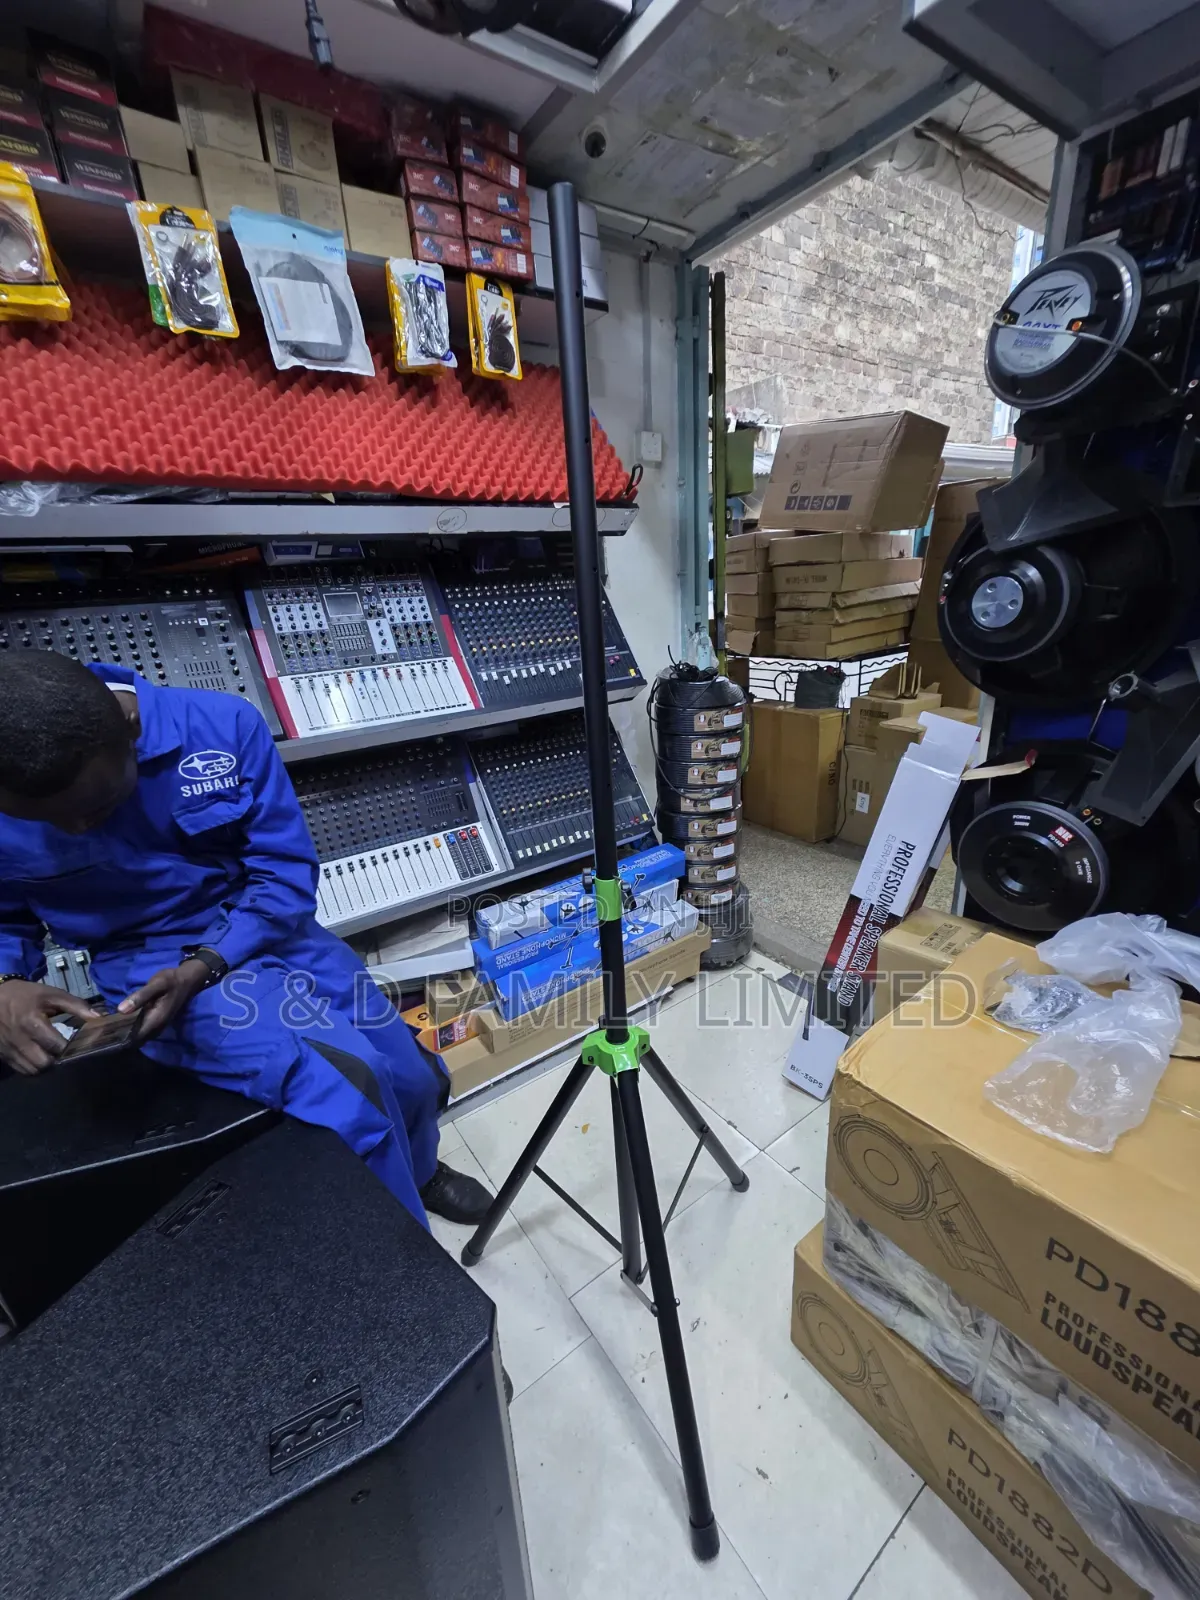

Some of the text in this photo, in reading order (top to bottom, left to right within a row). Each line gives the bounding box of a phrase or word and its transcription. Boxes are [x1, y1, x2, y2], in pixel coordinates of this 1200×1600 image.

[836, 839, 917, 1007] PROFESSIONAL SPEAKER STAND
[789, 1064, 824, 1089] BK-3SPS
[1040, 1305, 1200, 1441] LOUDSPEA
[947, 1428, 1113, 1595] PD1882D
[947, 1467, 1069, 1598] PROFESSIONAL
